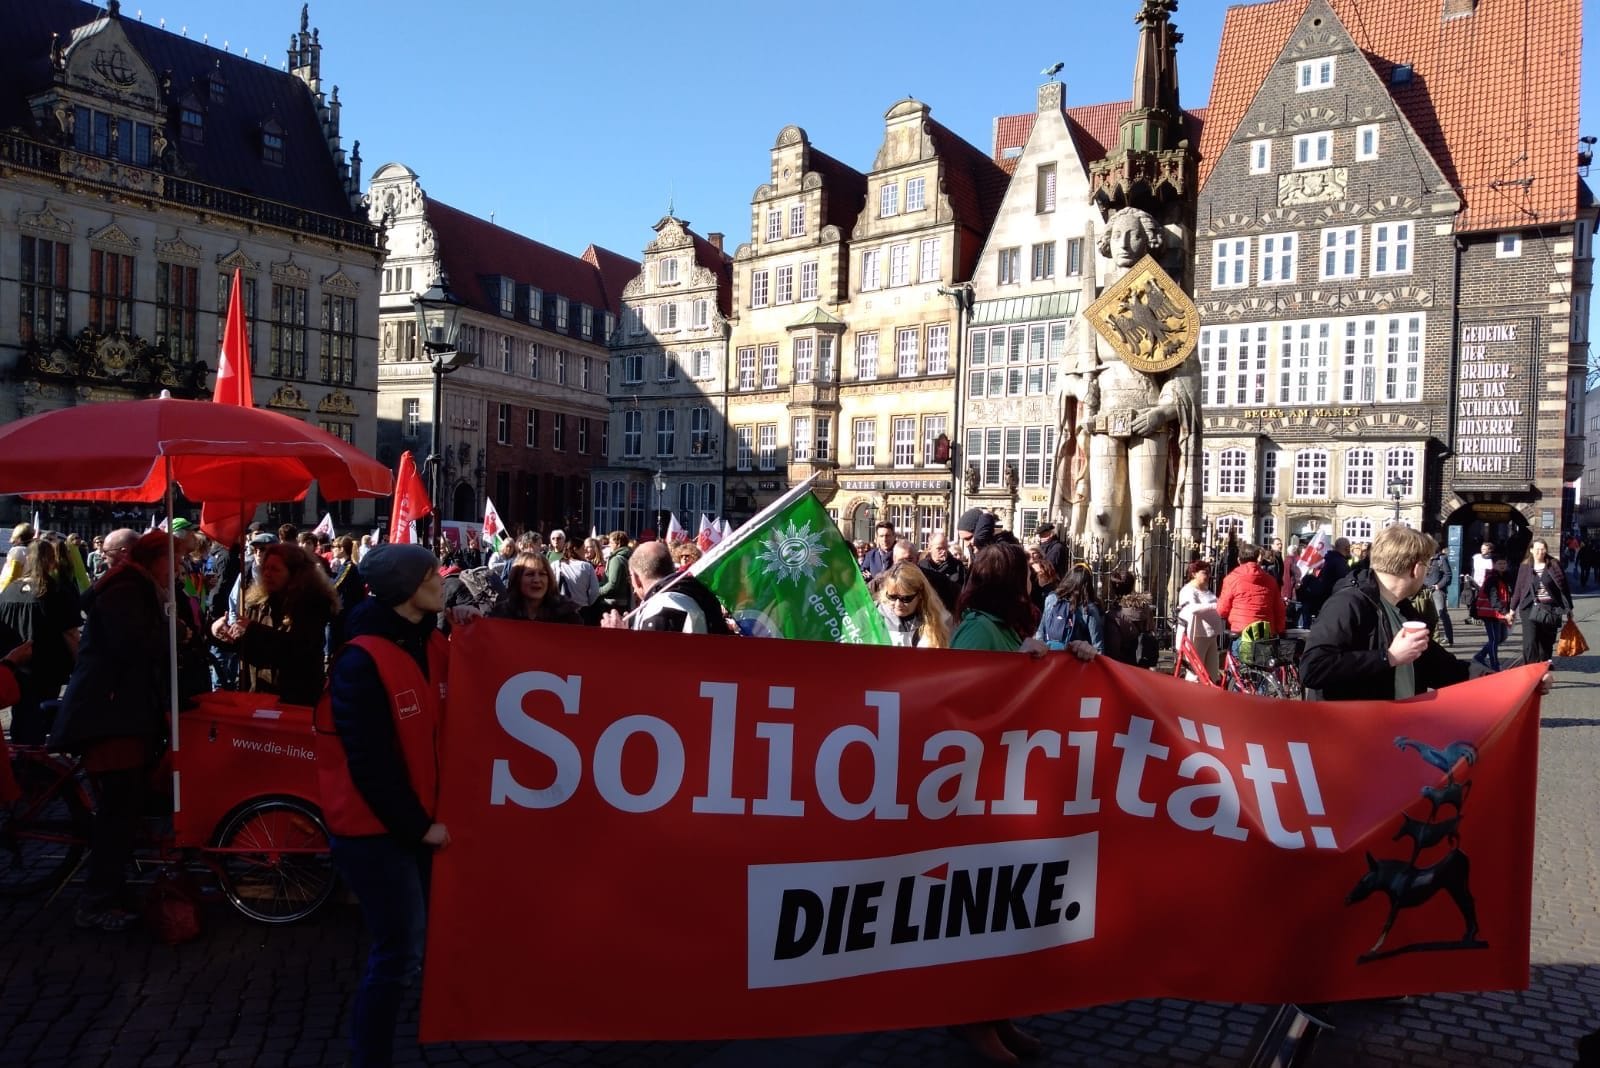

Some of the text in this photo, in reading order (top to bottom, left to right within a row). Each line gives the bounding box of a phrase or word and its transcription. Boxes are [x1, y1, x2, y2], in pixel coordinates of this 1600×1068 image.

[1462, 324, 1518, 342] GEDENKE
[1461, 345, 1487, 361] DER
[1460, 382, 1506, 398] DIE DAS
[1288, 408, 1309, 418] AM
[1313, 407, 1361, 417] MARKT
[1459, 400, 1523, 417] SCHICKSAL
[1458, 419, 1515, 435] UNSERER
[1457, 437, 1522, 454] TRENNUNG
[888, 480, 943, 490] APOTHEKE
[808, 594, 830, 617] der
[232, 738, 318, 761] www.die-linke.
[490, 670, 1338, 850] Solidarität!
[773, 880, 886, 961] DIE
